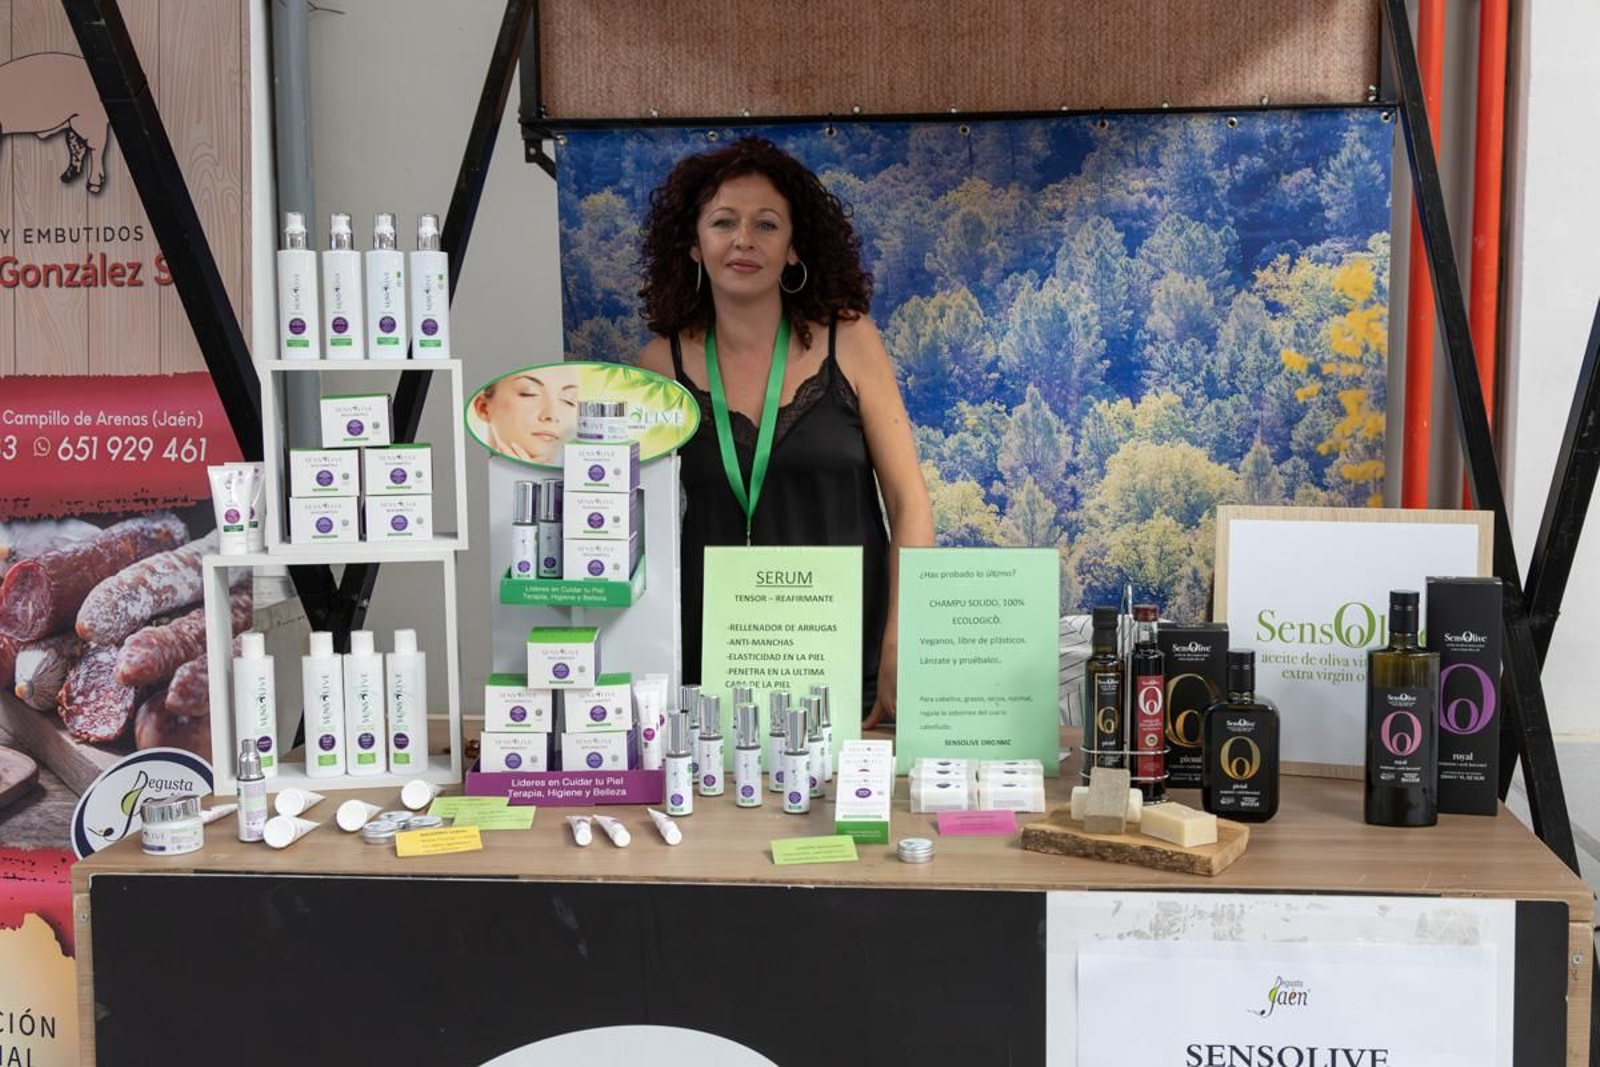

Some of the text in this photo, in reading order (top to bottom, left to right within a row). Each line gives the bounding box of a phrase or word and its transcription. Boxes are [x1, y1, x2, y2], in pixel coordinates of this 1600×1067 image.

[24, 225, 144, 243] EMBUTIDOS
[0, 252, 144, 288] González
[2, 409, 203, 428] Campillo de Arenas (Jaén)
[57, 436, 97, 461] 651
[106, 435, 153, 461] 929
[161, 437, 206, 463] 461
[756, 571, 813, 585] SERUM
[940, 570, 974, 579] probado
[735, 594, 767, 602] TENSOR
[775, 594, 834, 602] REAFIRMANTE
[929, 600, 966, 608] CHAMPU
[1003, 599, 1025, 607] 100%
[784, 624, 795, 632] DE
[797, 624, 837, 632] ARRUGAS
[958, 636, 976, 645] libre
[978, 636, 988, 645] de
[783, 653, 794, 661] EN
[796, 653, 806, 661] LA
[808, 653, 825, 661] PIEL
[919, 656, 950, 665] Lánzate
[1261, 653, 1298, 665] aceite
[1301, 651, 1316, 666] de
[1319, 652, 1349, 667] oliva
[767, 668, 779, 676] EN
[780, 668, 791, 676] LA
[792, 668, 825, 677] ULTIMA
[1281, 668, 1313, 680] extra
[1316, 668, 1354, 684] virgin
[762, 680, 773, 688] LA
[774, 680, 790, 688] PIEL
[1452, 751, 1473, 762] royal
[562, 778, 593, 786] Cuidar
[595, 778, 605, 786] tu
[606, 777, 624, 785] Piel
[507, 788, 627, 799] Terapia, Higiene y Belleza
[0, 1008, 55, 1039] IÓN
[1186, 1043, 1389, 1067] SENSOLIVE
